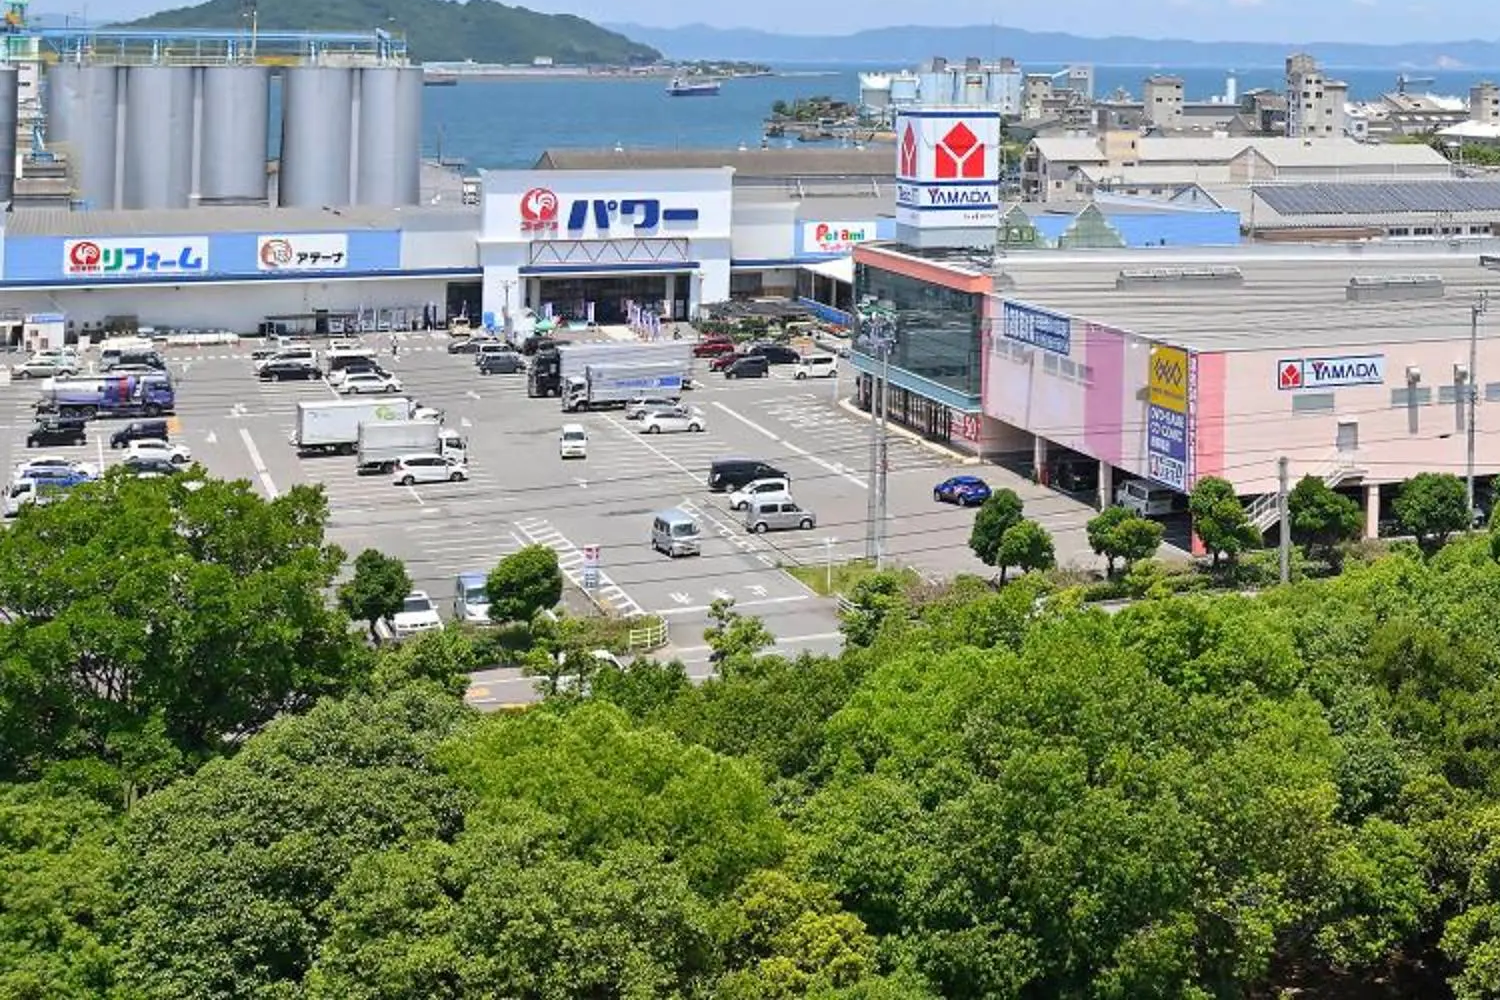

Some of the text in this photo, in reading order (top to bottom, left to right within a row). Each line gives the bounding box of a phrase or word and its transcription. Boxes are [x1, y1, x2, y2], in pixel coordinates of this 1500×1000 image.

[927, 188, 991, 203] YAMADA
[568, 199, 699, 230] パワー
[103, 247, 202, 271] リフォーム
[1312, 362, 1379, 380] YAMADA
